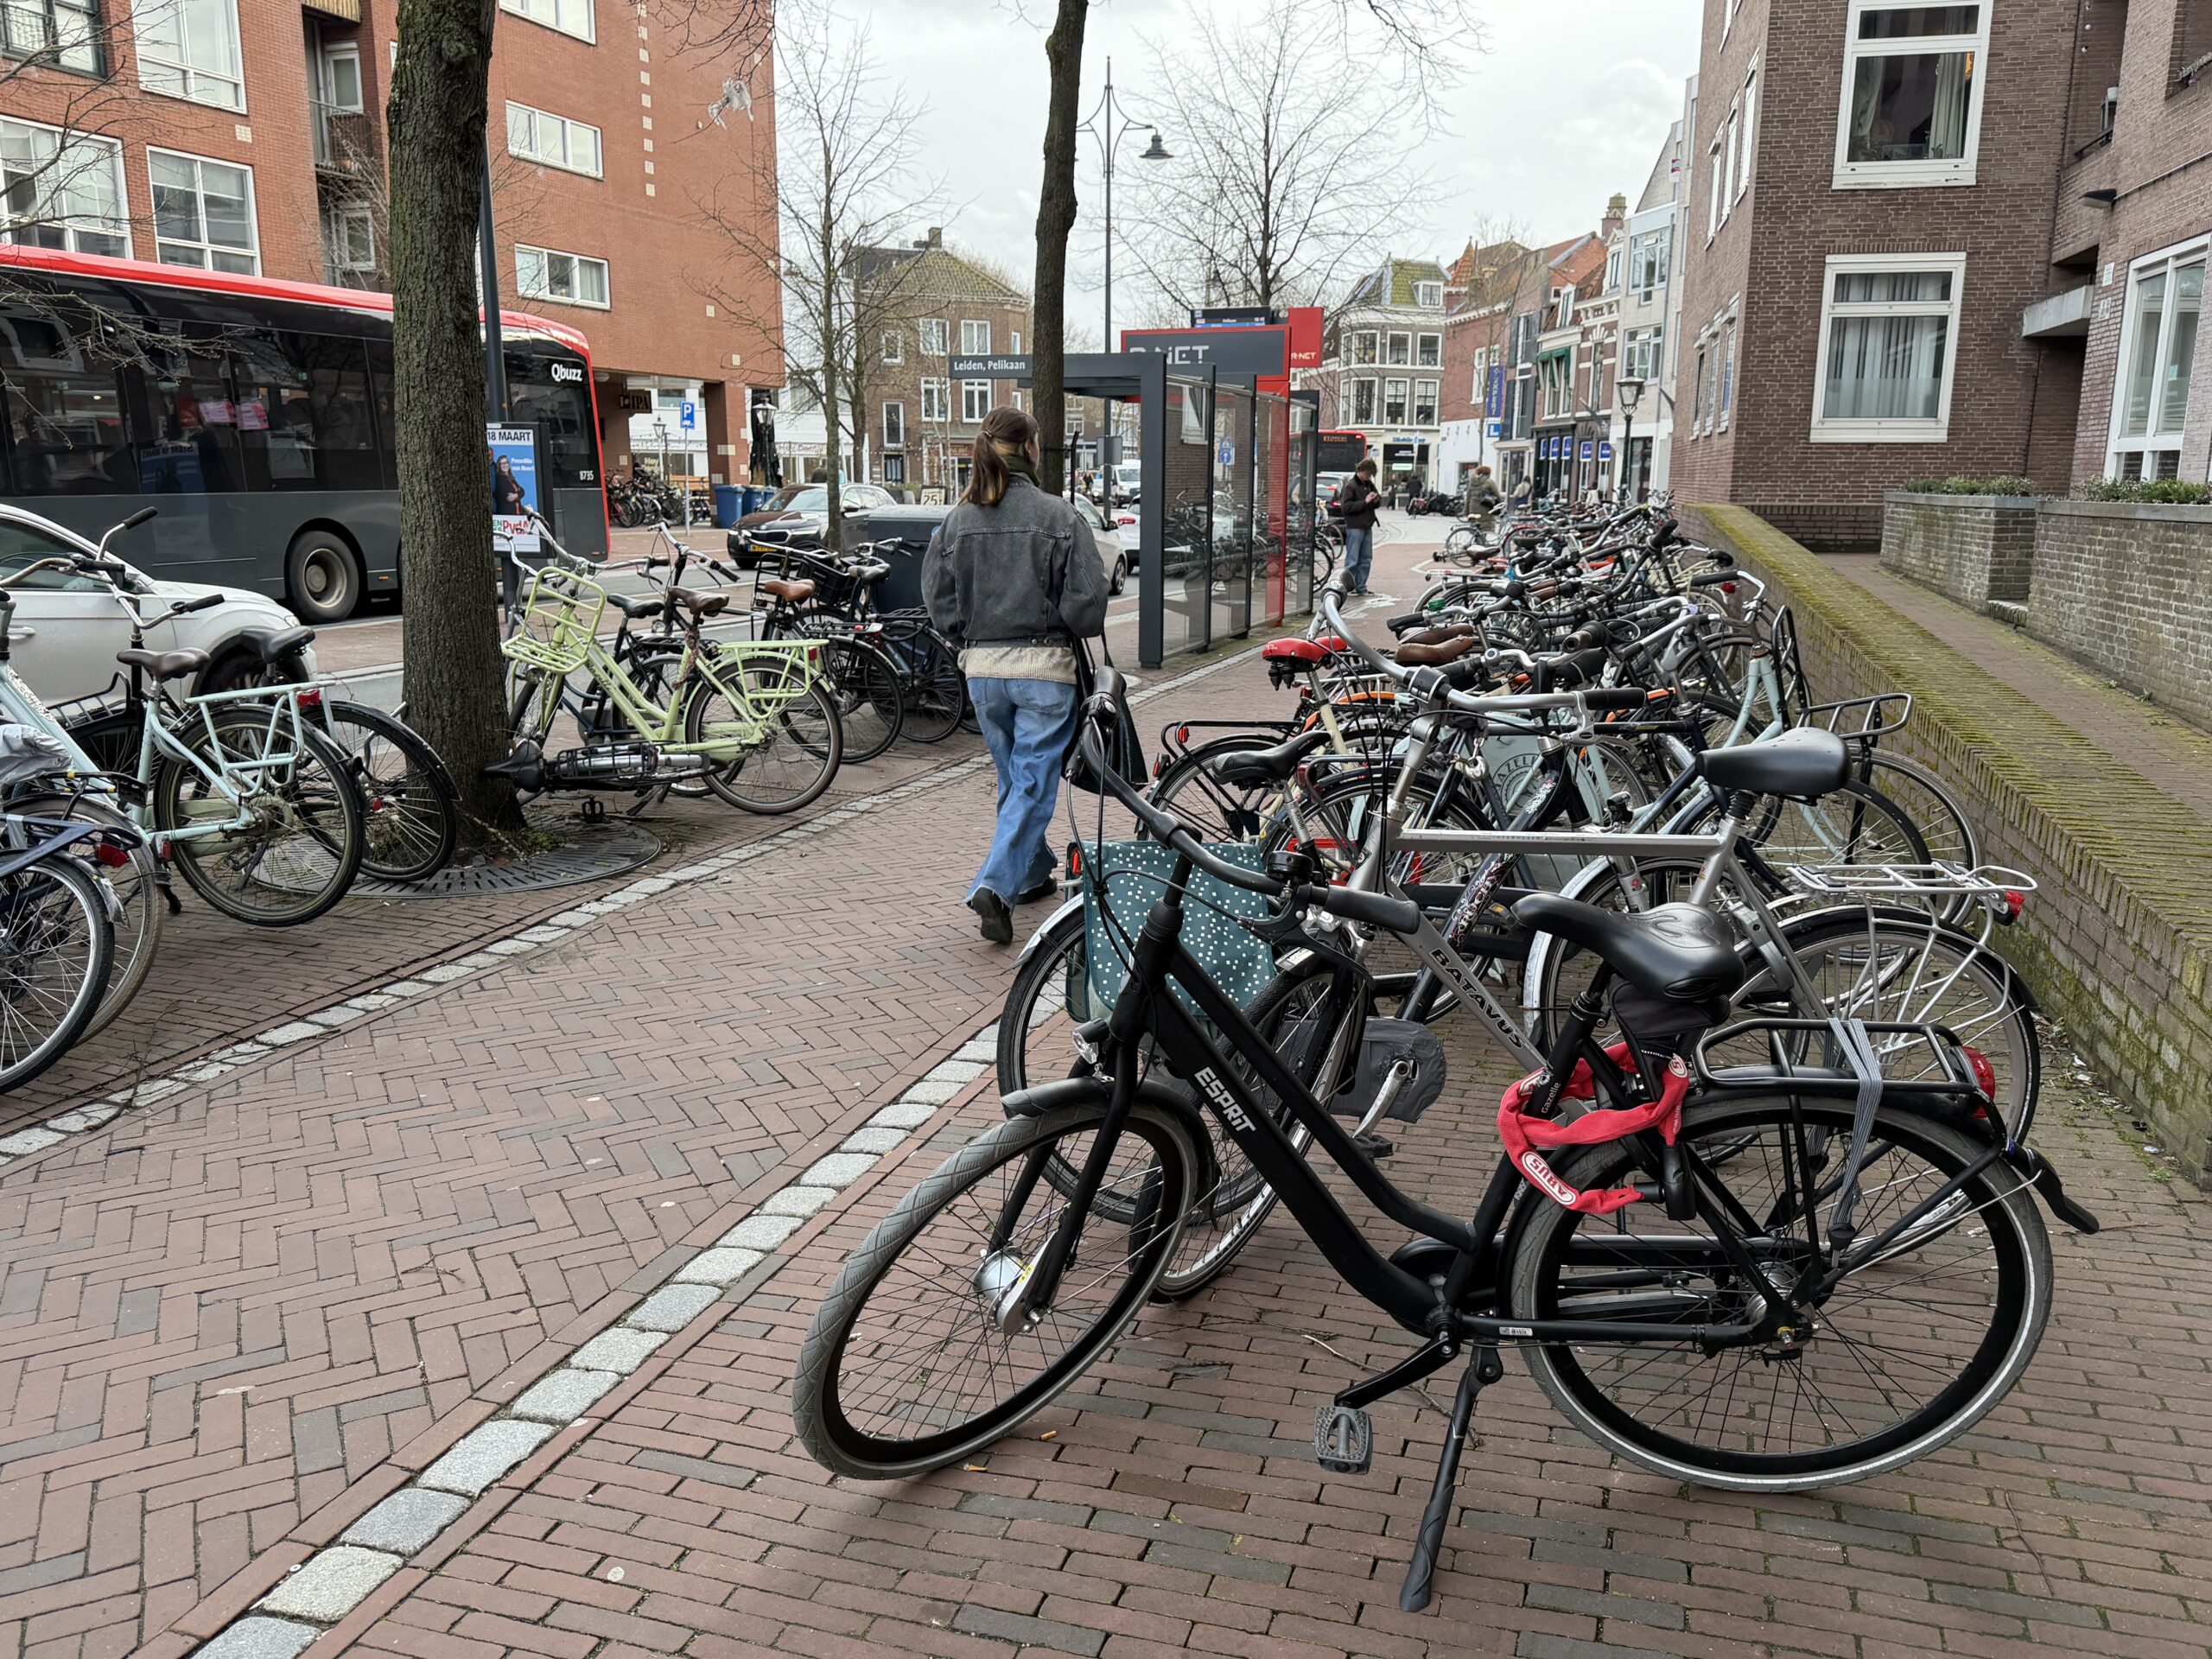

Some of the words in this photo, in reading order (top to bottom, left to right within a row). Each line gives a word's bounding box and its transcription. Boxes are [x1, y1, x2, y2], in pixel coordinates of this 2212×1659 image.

[551, 363, 582, 382] Qbuzz
[954, 360, 986, 371] Leiden,
[988, 359, 1026, 370] Pelikaan
[683, 405, 691, 418] P
[487, 431, 497, 441] 18
[499, 431, 531, 442] MAART
[580, 470, 594, 480] 8735
[1429, 948, 1522, 1049] BATAVUS
[1194, 1066, 1256, 1132] ESPRIT
[1541, 1082, 1561, 1114] Gazelle
[1529, 1158, 1567, 1197] ABUS
